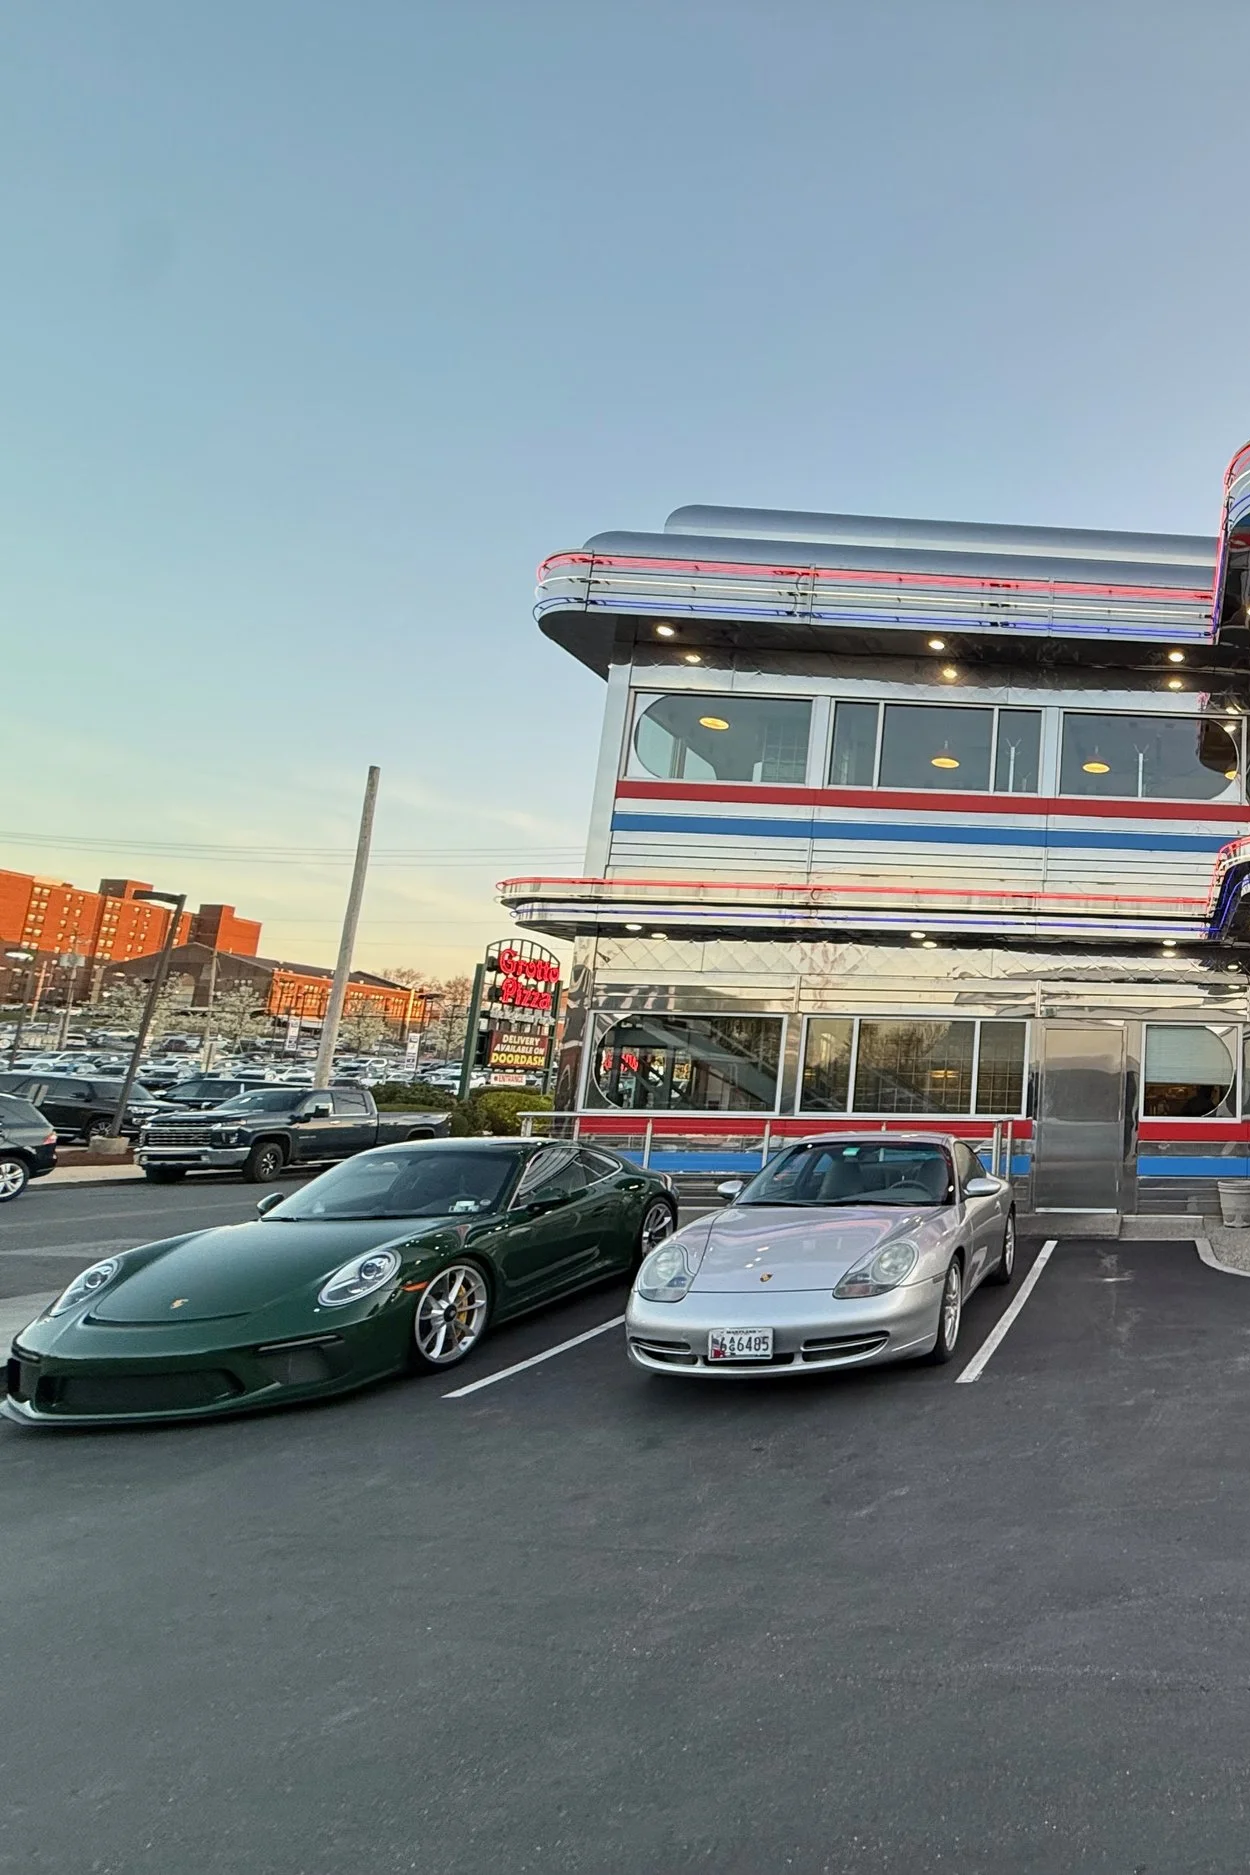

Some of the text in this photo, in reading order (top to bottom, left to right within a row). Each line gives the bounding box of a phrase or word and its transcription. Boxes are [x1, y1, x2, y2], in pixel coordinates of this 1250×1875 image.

[498, 948, 560, 983] Grotto
[501, 977, 551, 1010] Pizza
[502, 1034, 541, 1046] DELIVERY
[494, 1044, 545, 1055] AVAILABLE ON
[490, 1053, 545, 1066] DOORDASH
[498, 1075, 524, 1083] ENTRANCE
